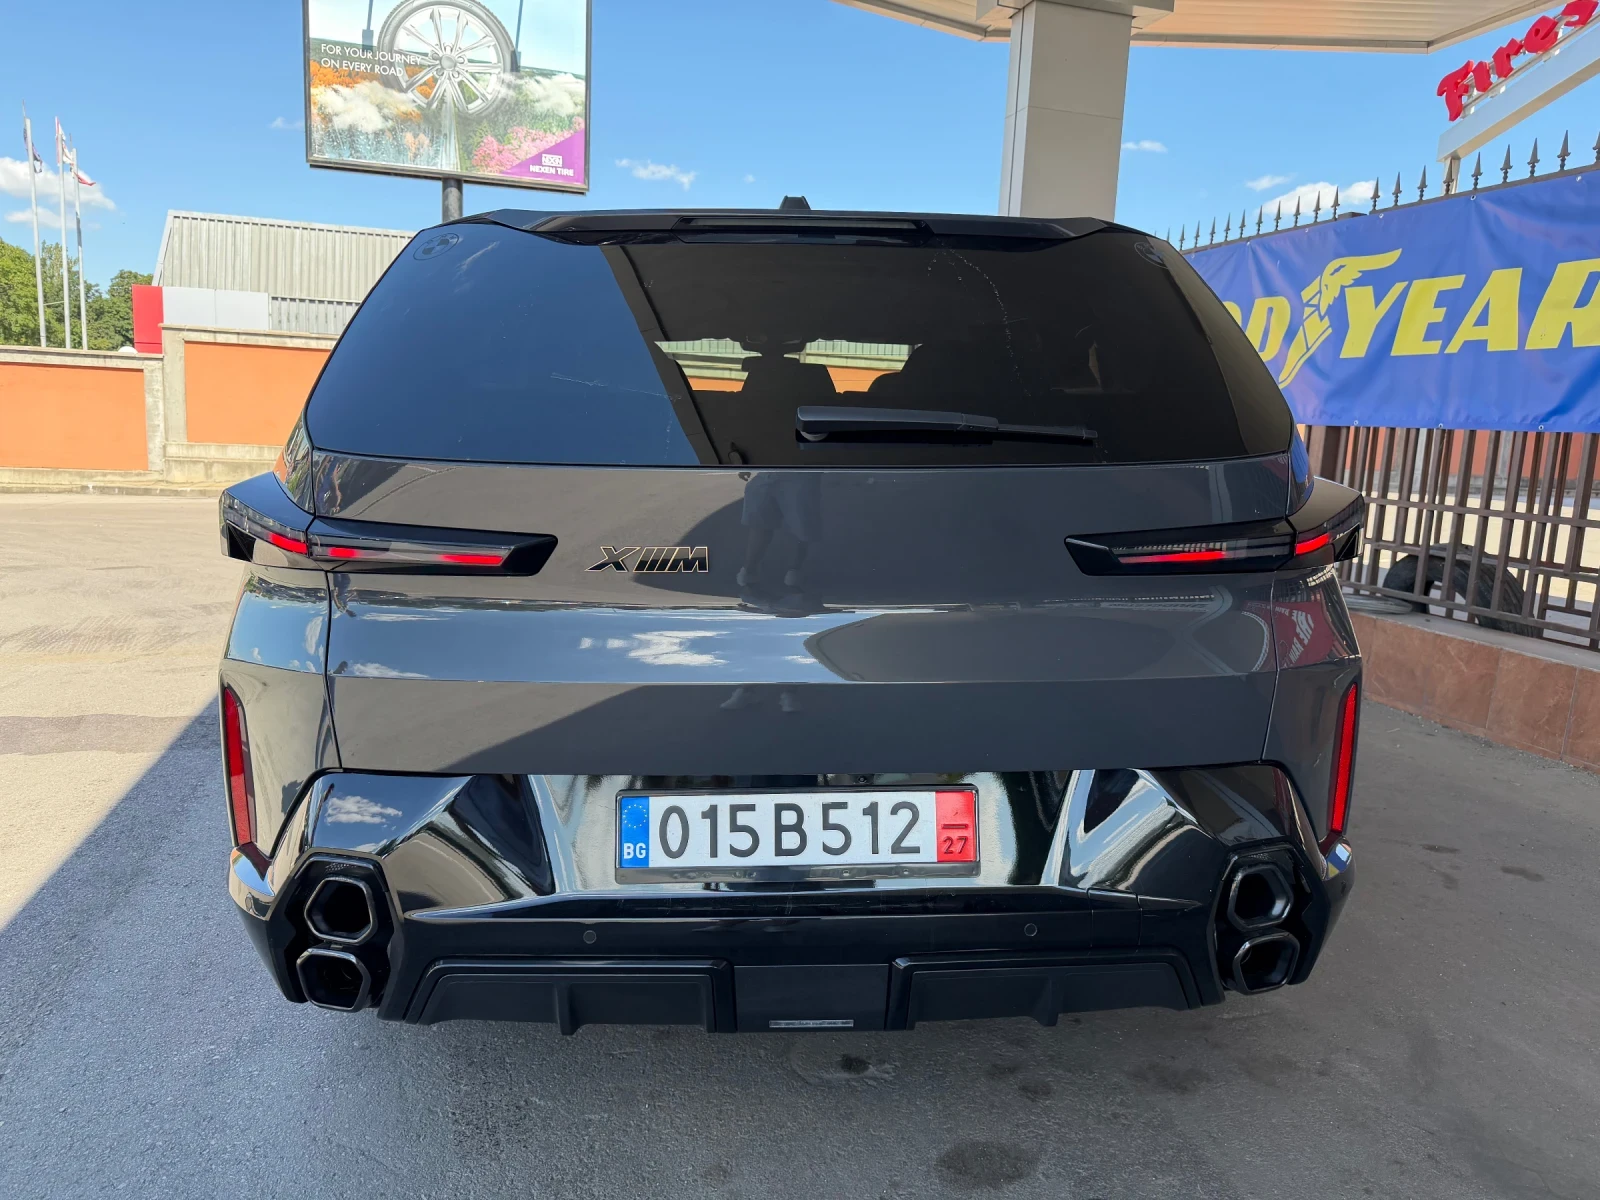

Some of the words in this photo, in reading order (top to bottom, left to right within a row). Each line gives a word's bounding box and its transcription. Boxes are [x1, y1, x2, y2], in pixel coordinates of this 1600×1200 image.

[321, 44, 342, 56] FOR
[344, 46, 373, 59] YOUR
[374, 51, 422, 66] JOURNEY
[321, 58, 340, 69] ON
[342, 60, 372, 73] EVERY
[374, 65, 404, 77] ROAD
[557, 167, 574, 177] TIRE
[623, 842, 647, 859] BG
[943, 835, 969, 854] 27
